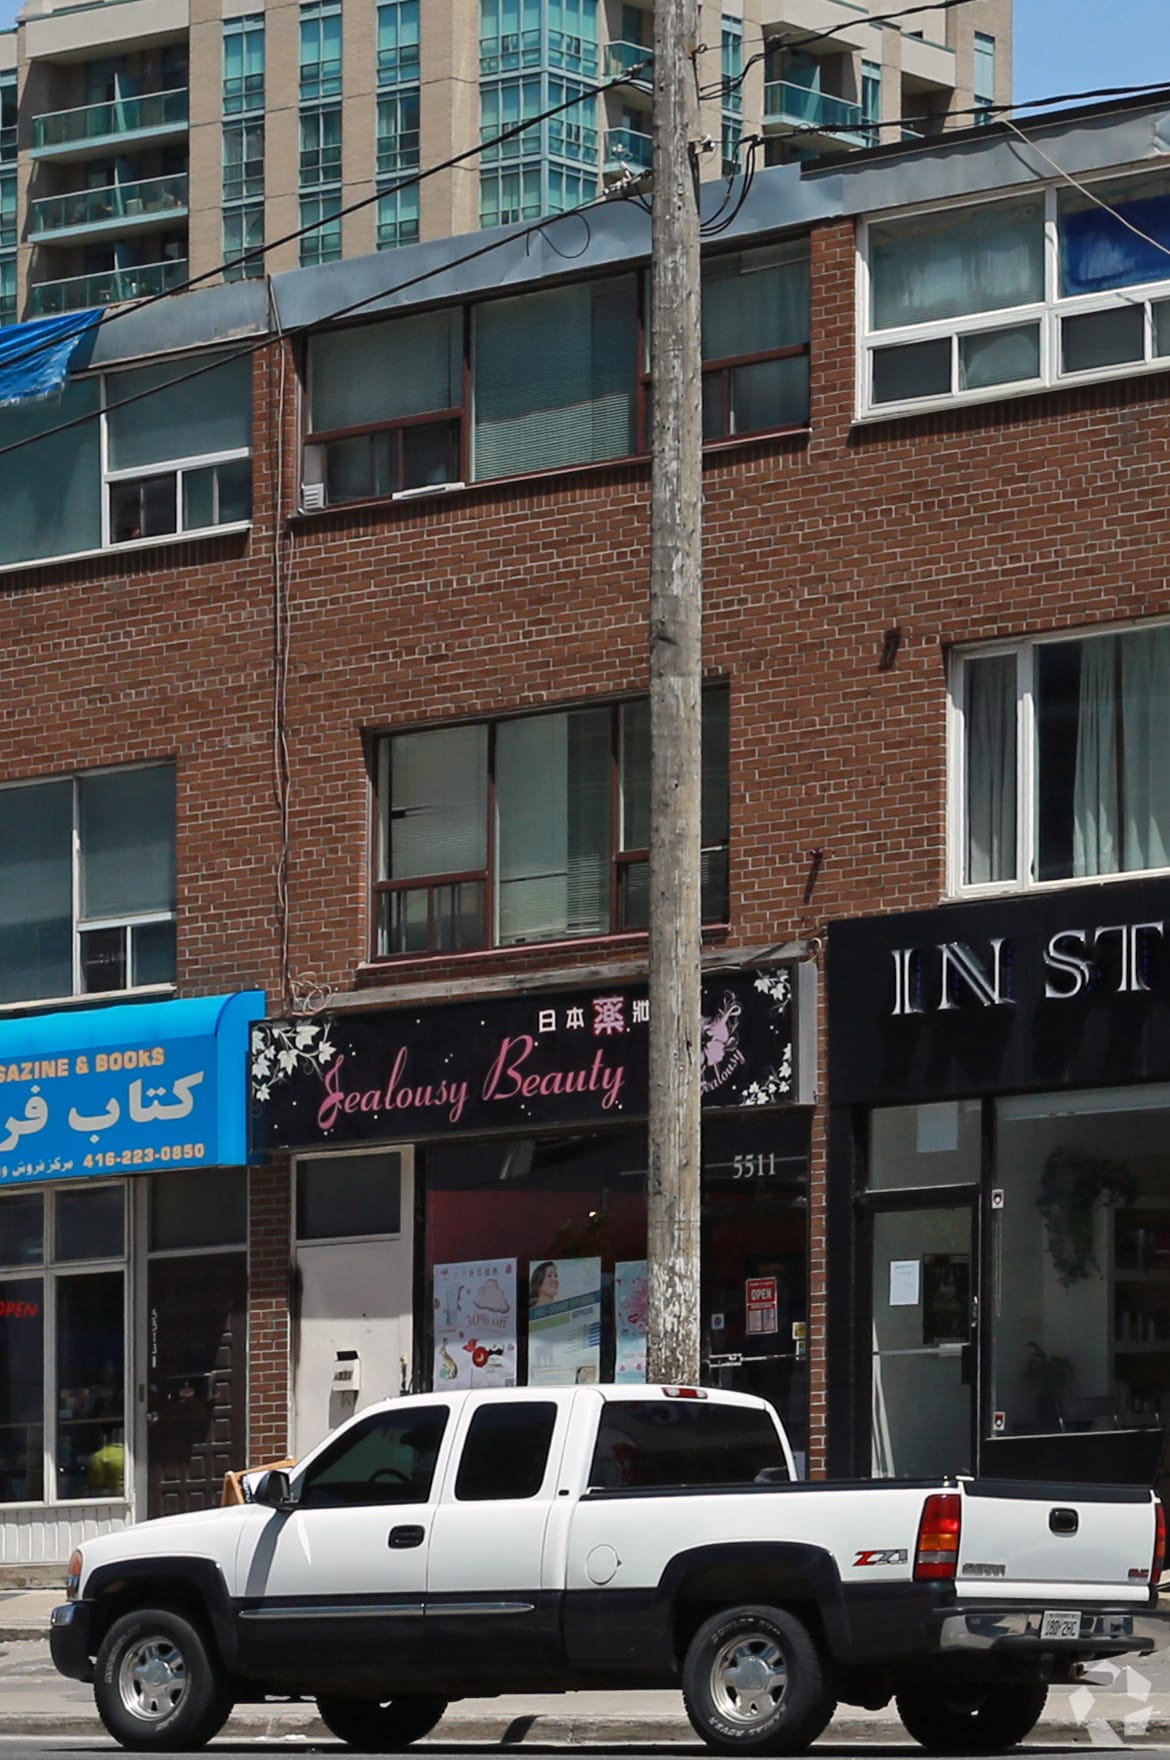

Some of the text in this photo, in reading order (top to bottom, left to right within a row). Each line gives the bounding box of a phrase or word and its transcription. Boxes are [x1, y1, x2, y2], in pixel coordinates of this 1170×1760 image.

[891, 921, 1164, 1015] IN ST
[75, 1055, 90, 1075] &
[96, 1047, 165, 1072] BOOKS
[317, 1034, 625, 1129] Jealousy Beauty
[68, 1071, 205, 1144] کتاب
[82, 1144, 205, 1168] 416-223-0850
[732, 1153, 776, 1178] 5511
[751, 1288, 773, 1300] OPEN
[851, 1549, 908, 1567] Z71
